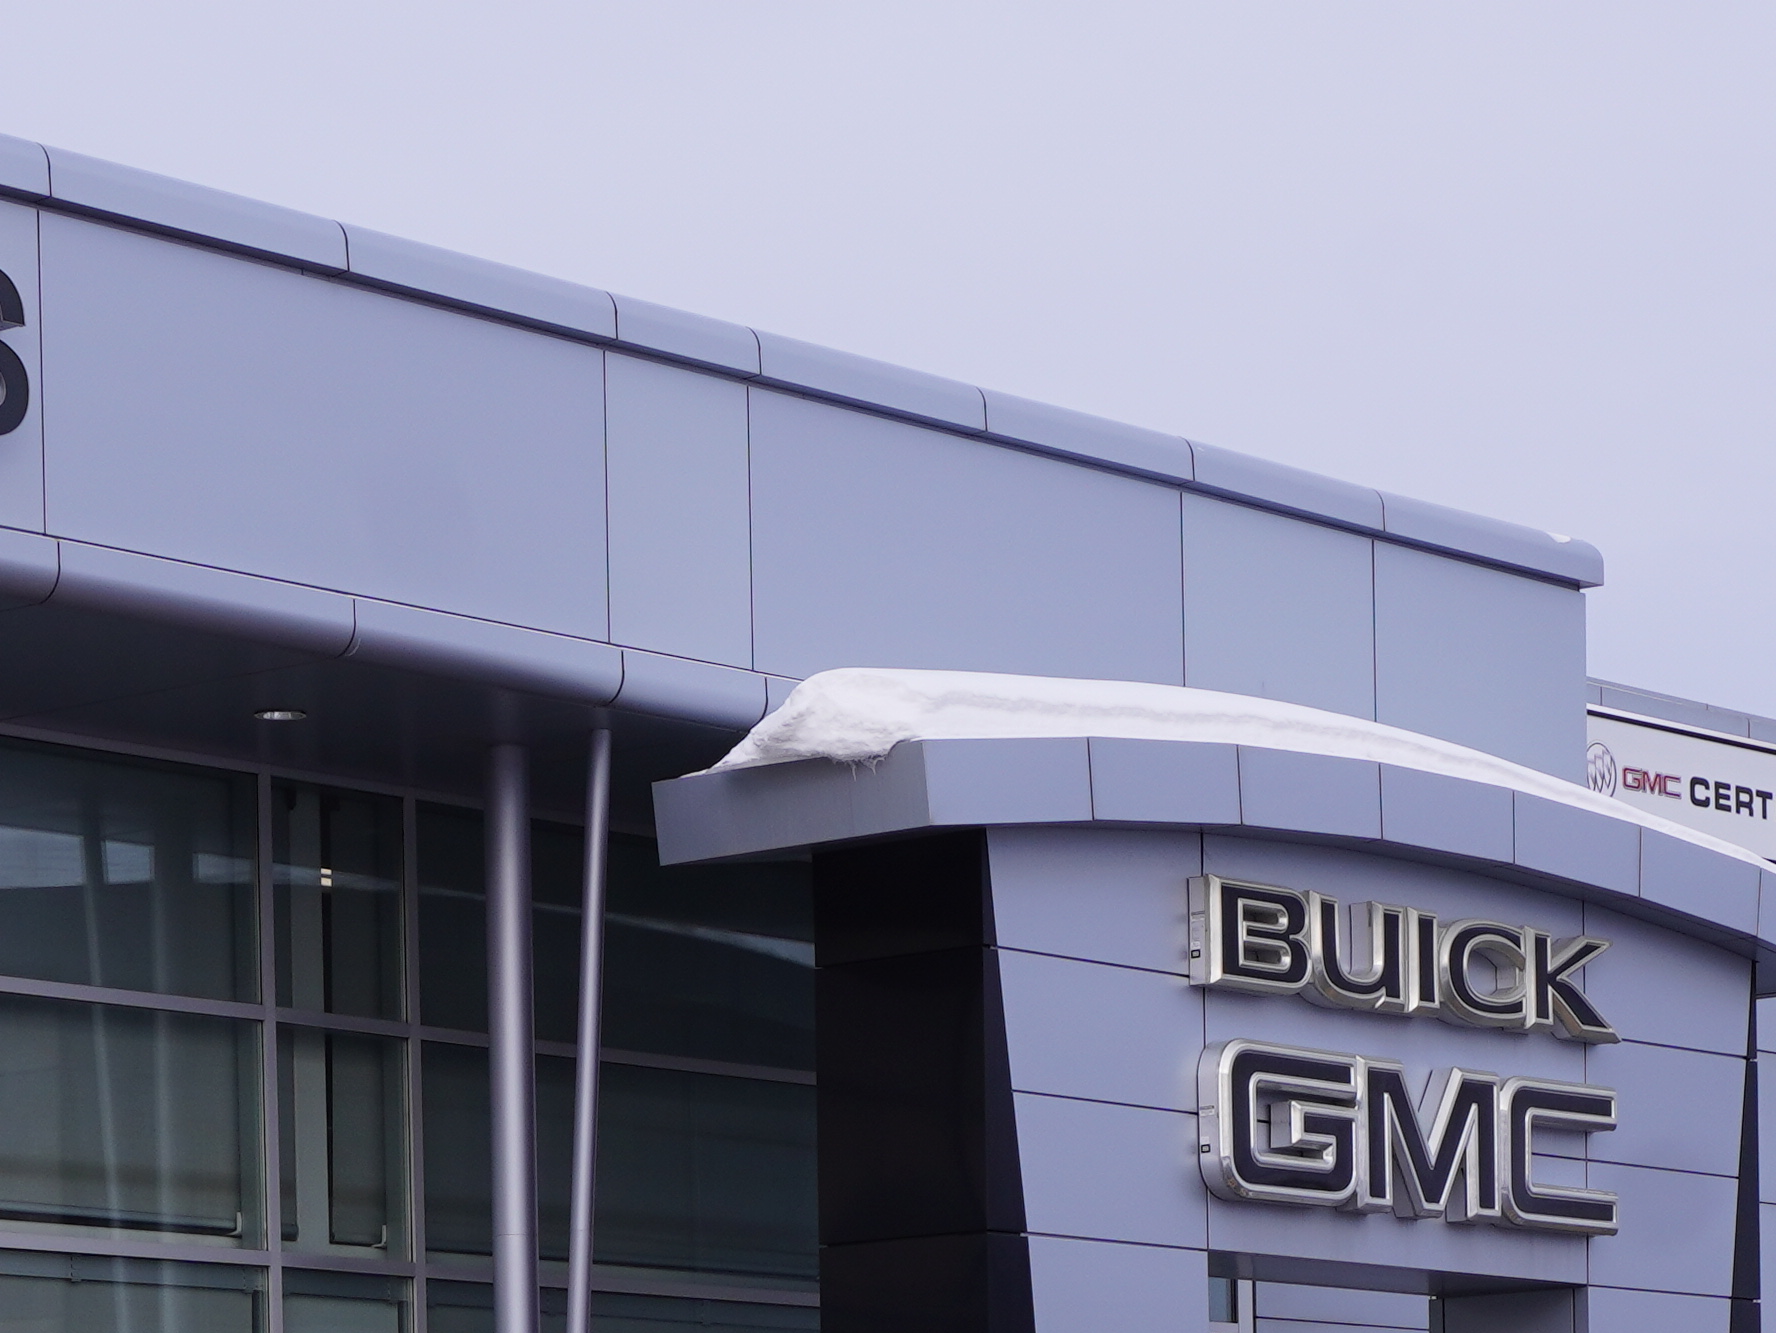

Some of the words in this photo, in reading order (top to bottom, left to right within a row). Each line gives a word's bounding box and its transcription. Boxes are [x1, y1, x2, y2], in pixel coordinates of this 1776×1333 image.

[1622, 766, 1682, 800] GMC
[1188, 874, 1622, 1045] BUICK
[1198, 1038, 1619, 1237] GMC
